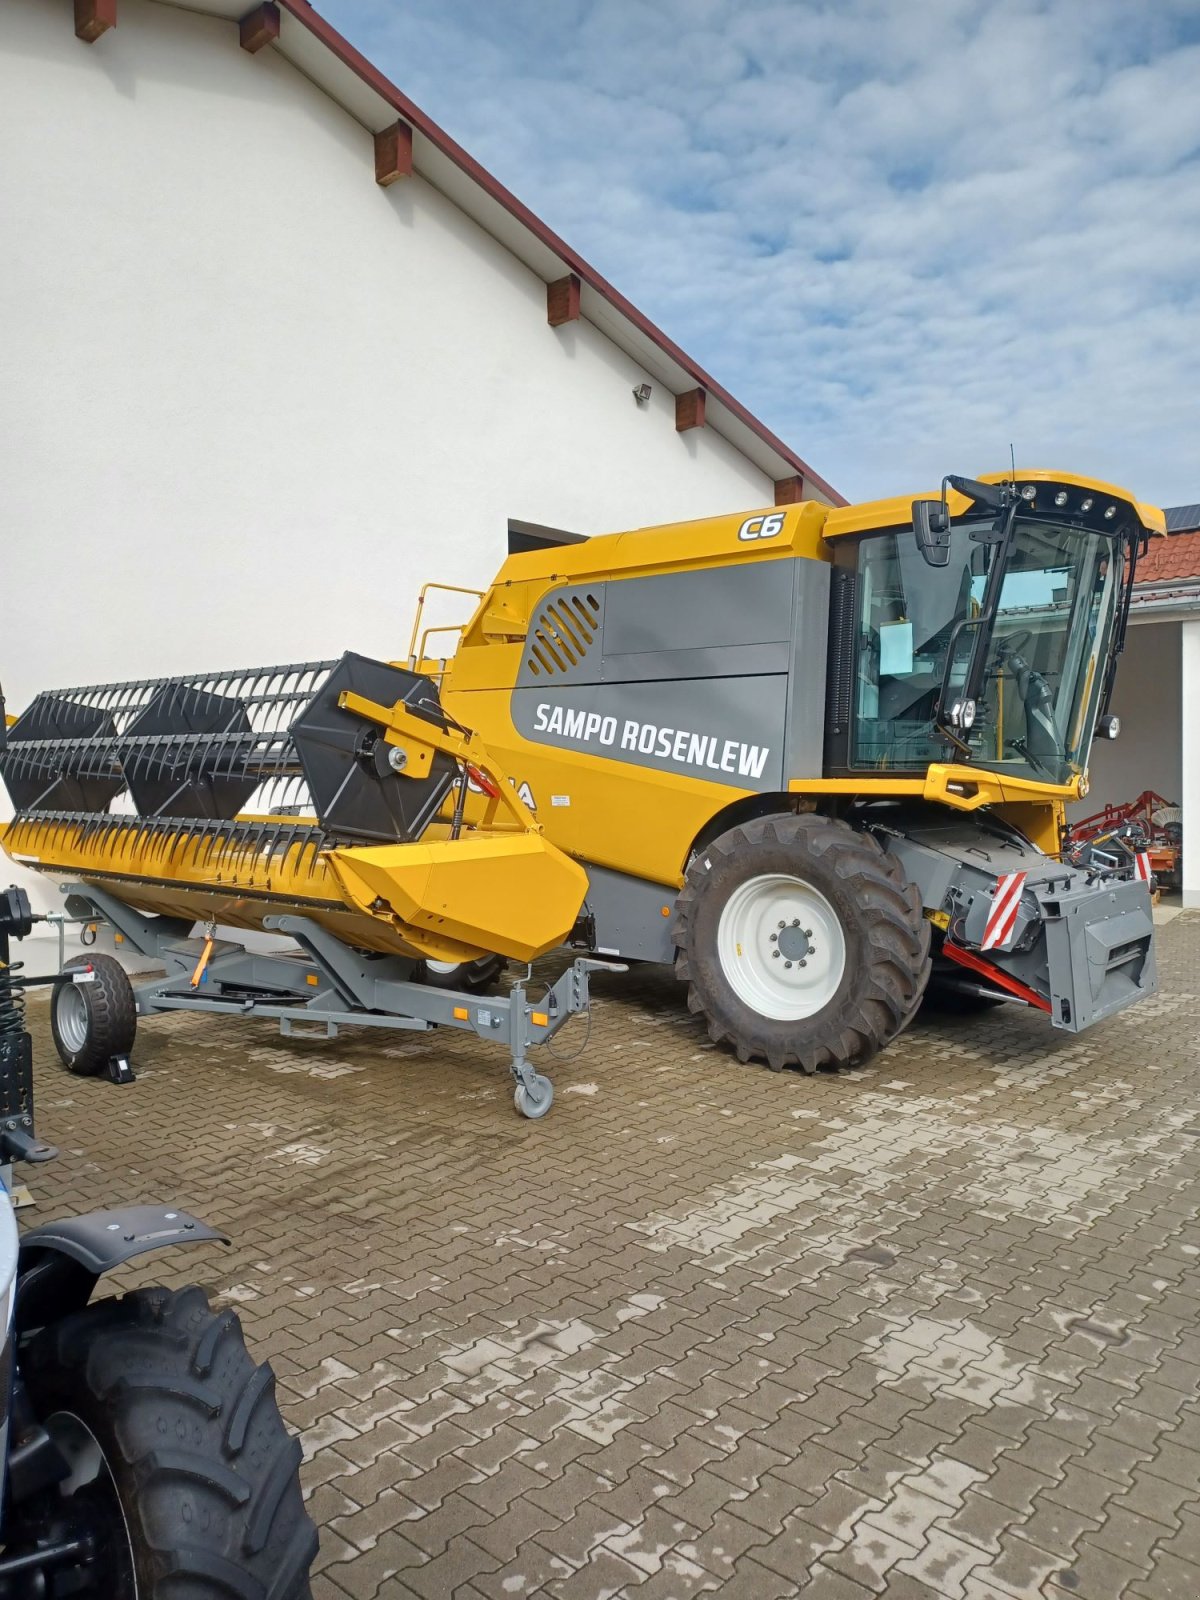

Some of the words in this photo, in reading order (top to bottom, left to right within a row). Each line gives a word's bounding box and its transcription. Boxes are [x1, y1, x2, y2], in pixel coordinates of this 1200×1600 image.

[738, 512, 787, 541] C6
[533, 703, 618, 746] SAMPO
[620, 720, 770, 779] ROSENLEW
